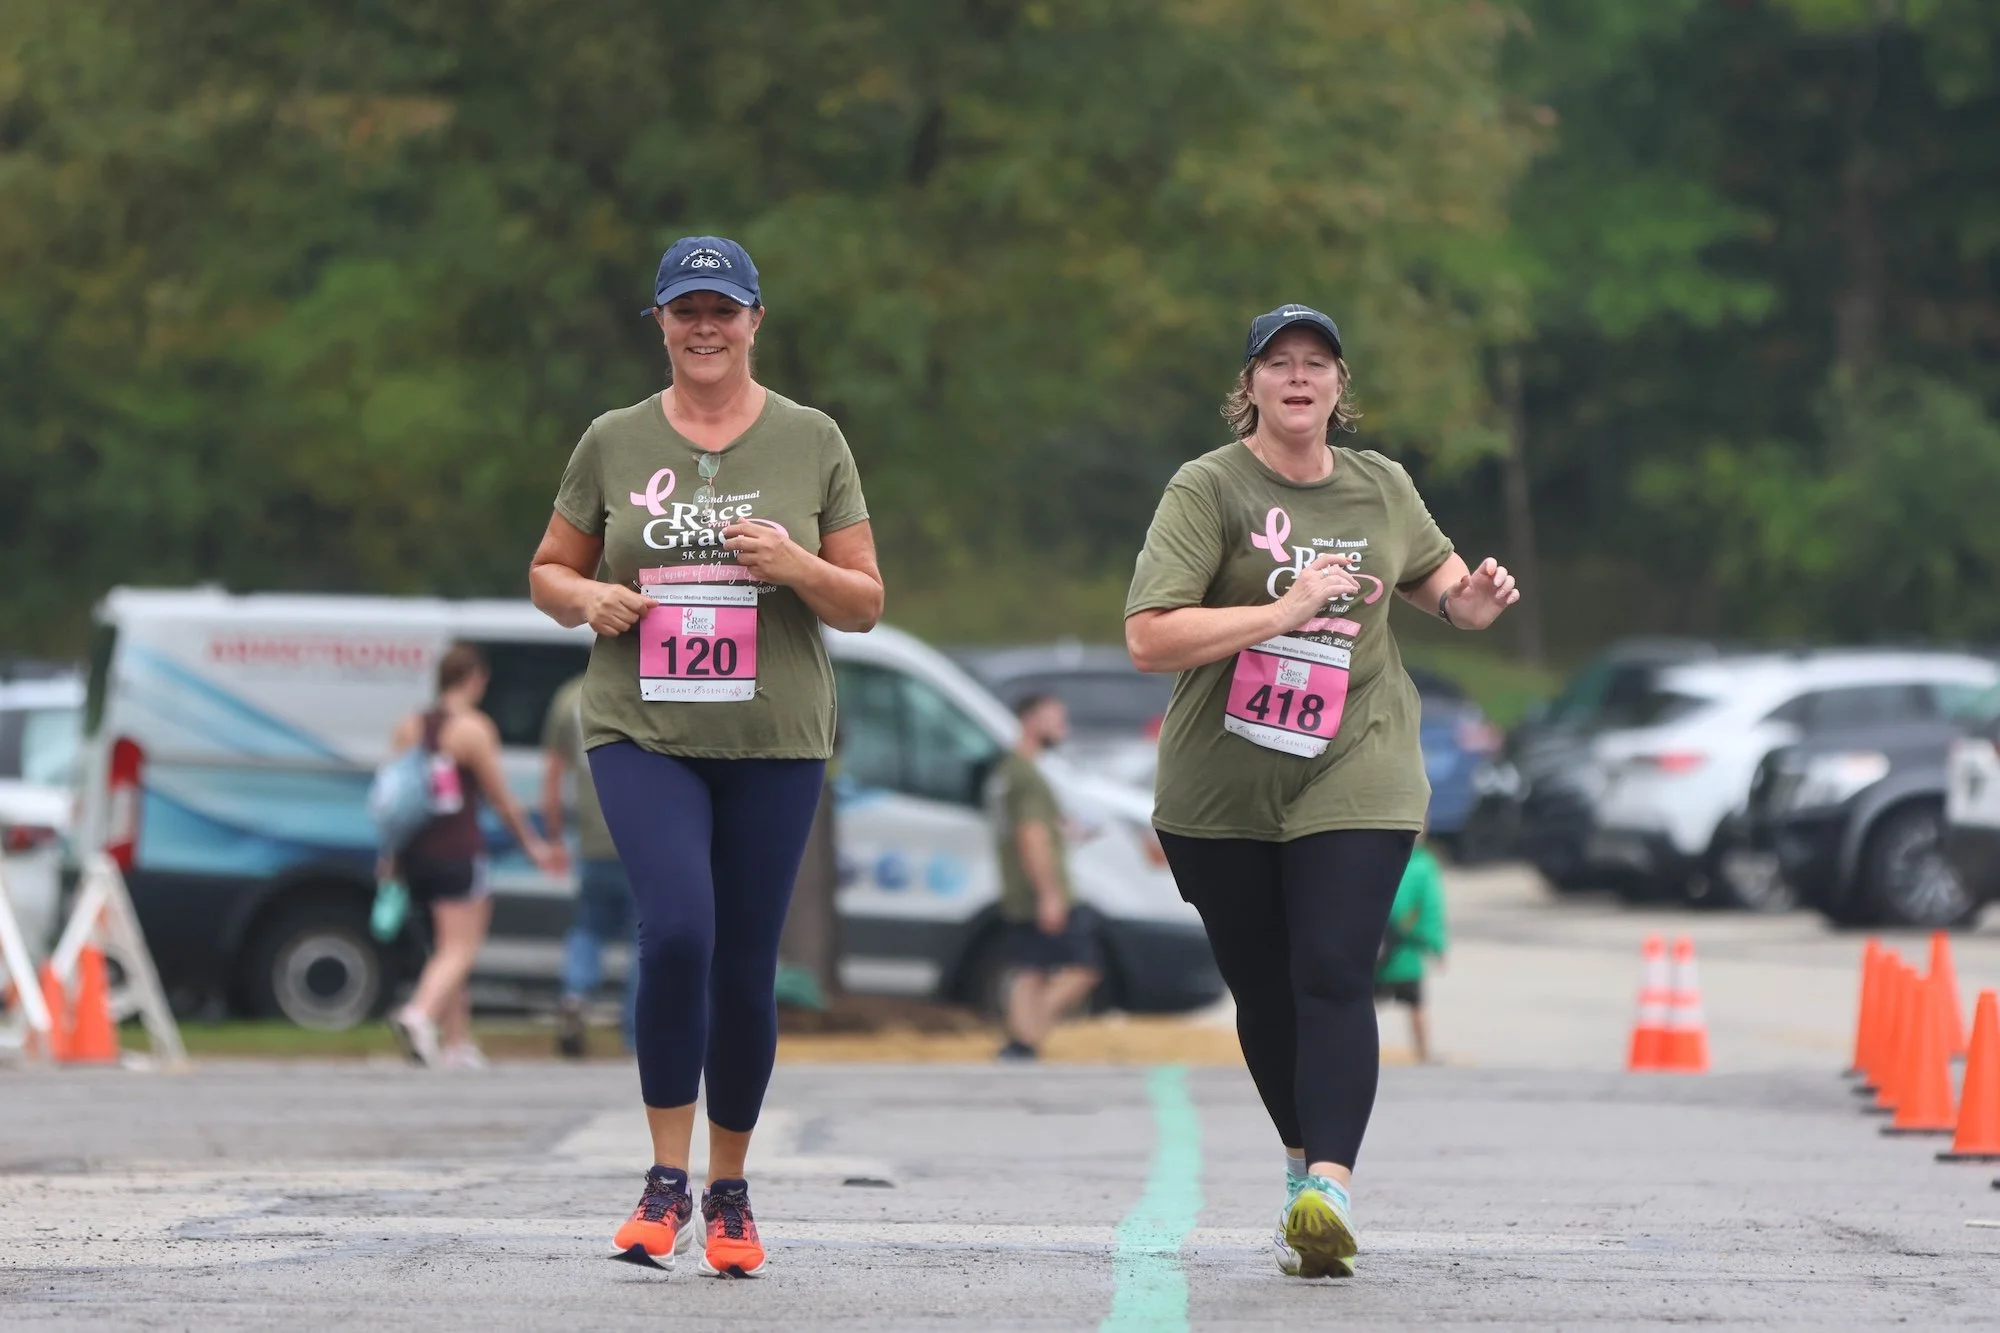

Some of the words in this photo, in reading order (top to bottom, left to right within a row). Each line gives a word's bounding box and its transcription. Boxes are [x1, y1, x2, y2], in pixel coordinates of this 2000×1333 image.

[725, 490, 760, 502] Annual
[671, 502, 752, 531] Race
[682, 550, 696, 560] 5K
[699, 550, 707, 558] &
[710, 549, 730, 558] Fun
[1312, 538, 1334, 547] 22nd
[1336, 538, 1368, 548] Annual
[1292, 545, 1362, 580] Re
[660, 636, 738, 676] 120
[1246, 684, 1325, 732] 418
